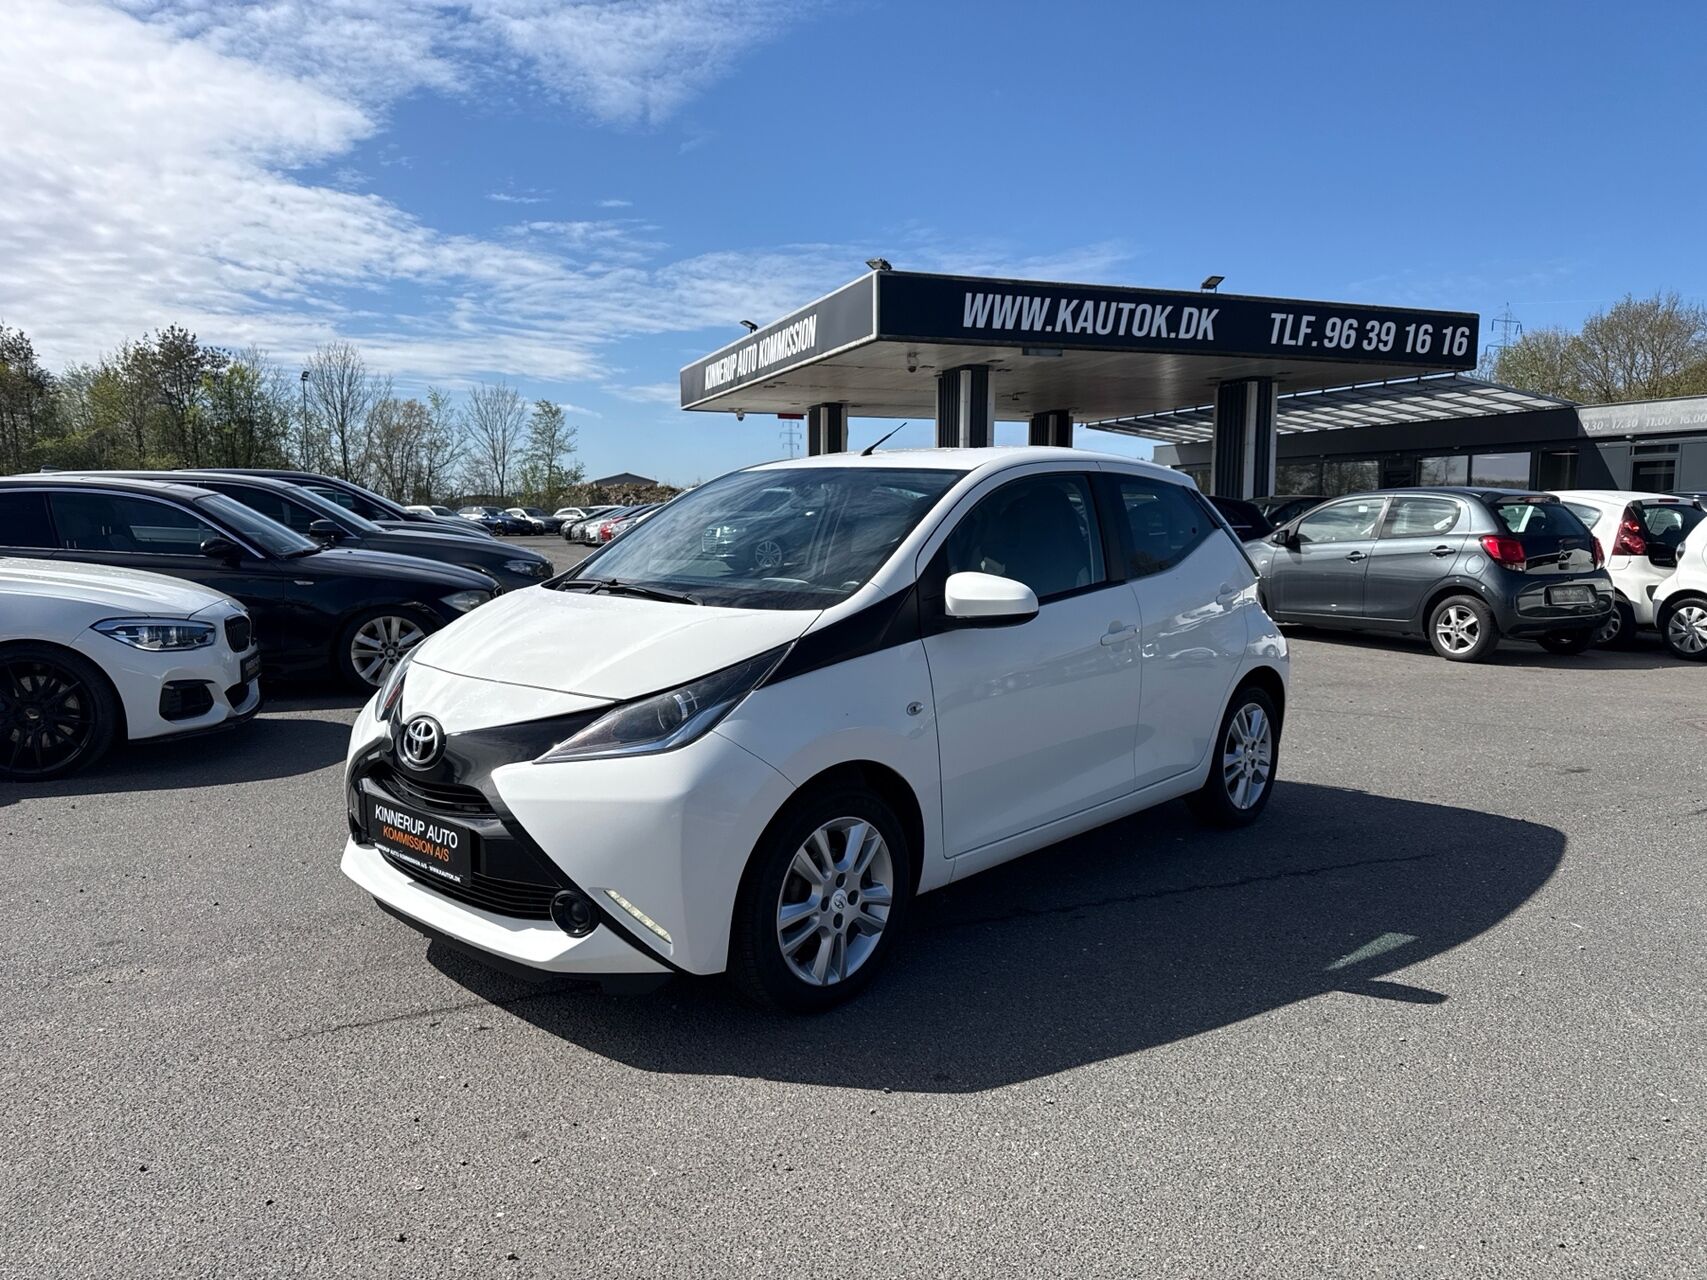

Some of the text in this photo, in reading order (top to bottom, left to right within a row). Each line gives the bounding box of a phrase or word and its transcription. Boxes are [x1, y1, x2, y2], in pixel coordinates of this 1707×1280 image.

[963, 292, 1219, 341] WWW.KAUTOK.DK
[1270, 313, 1470, 357] TLF. 96 39 16 16
[704, 314, 817, 391] KINNERUP AUTO KOMMISSION
[375, 804, 458, 849] KINNERUP AUTO
[383, 825, 434, 856] KOMMISSION
[434, 846, 450, 862] A/S
